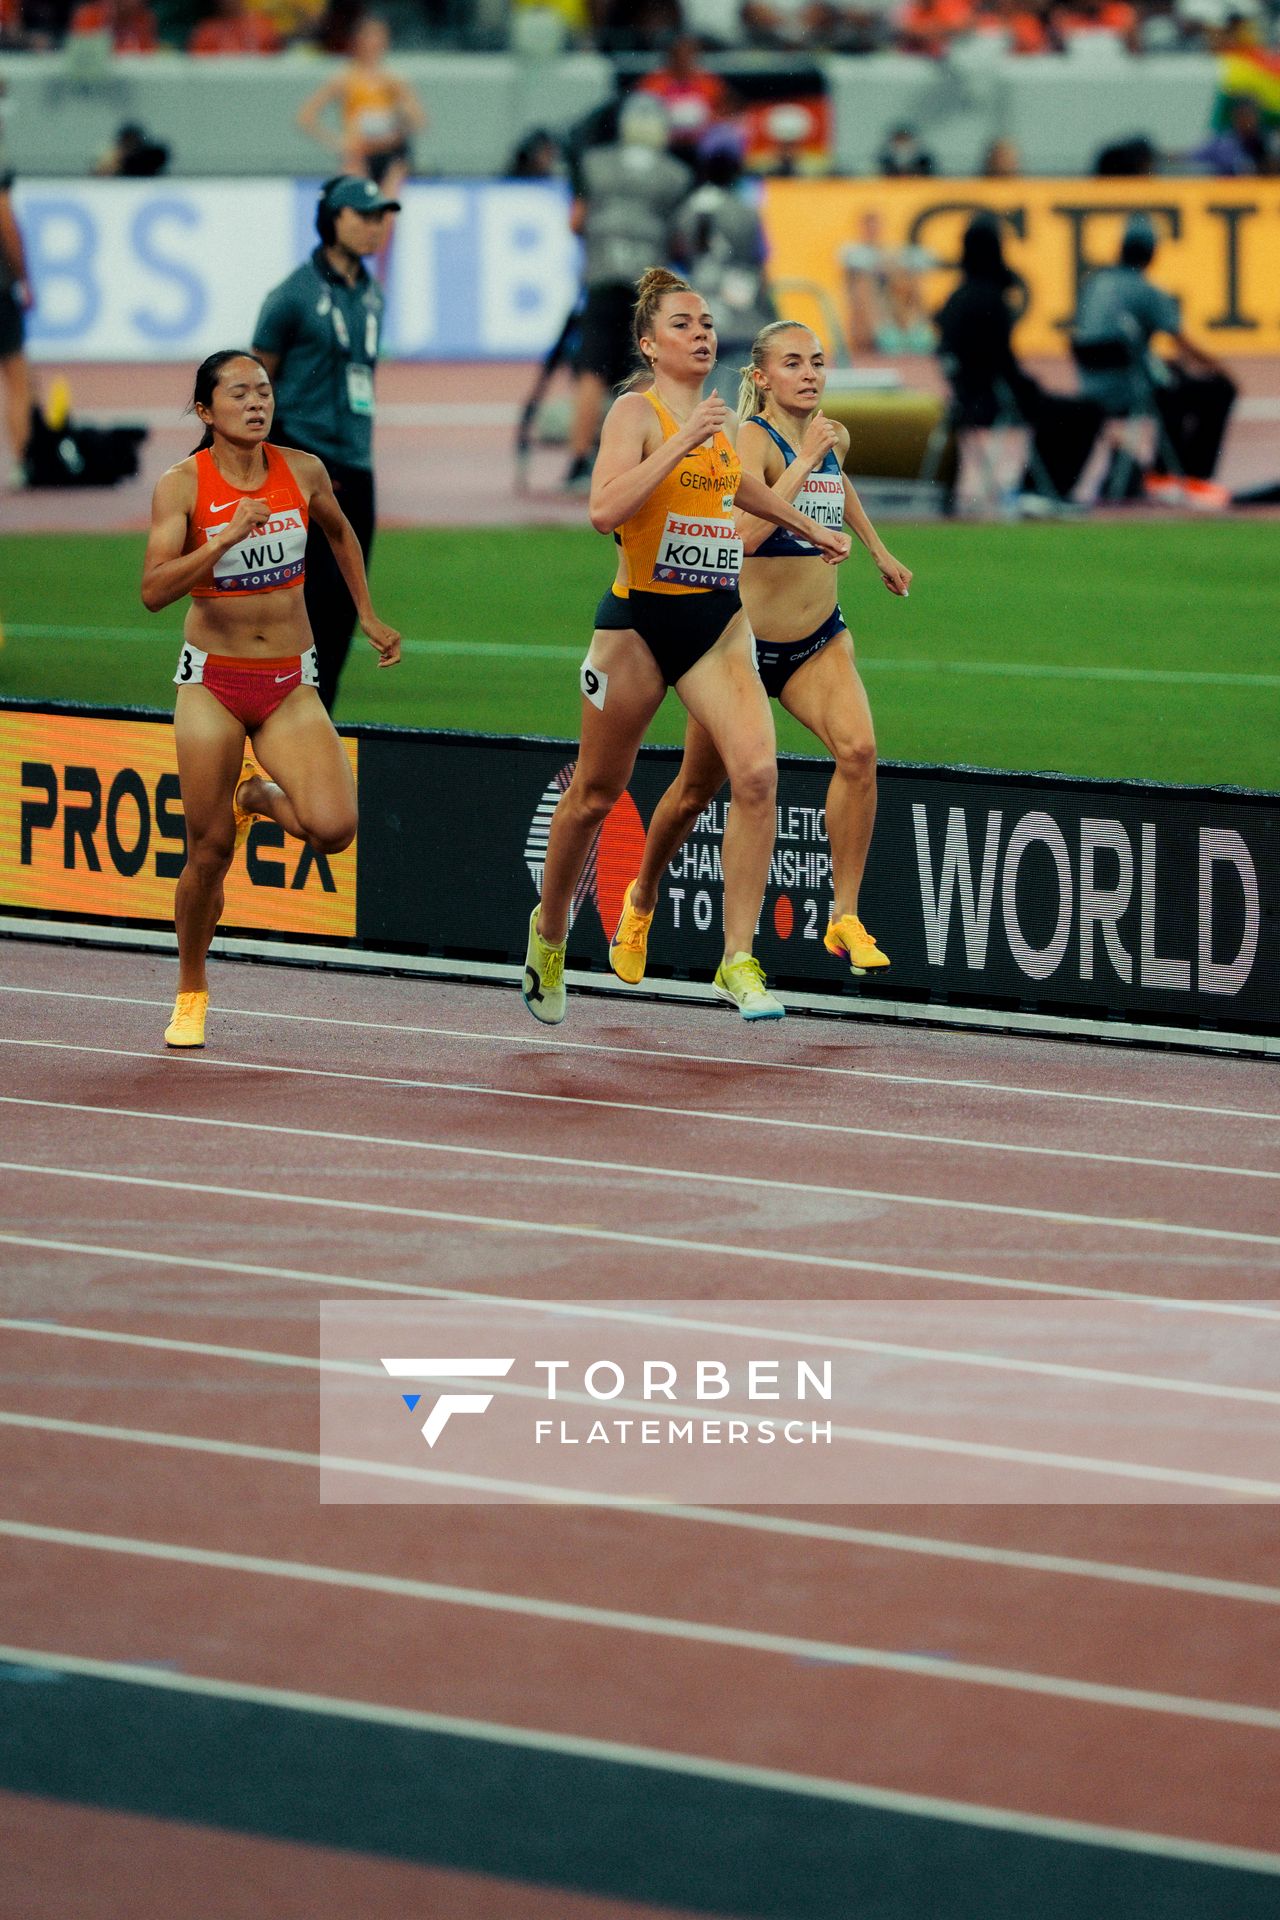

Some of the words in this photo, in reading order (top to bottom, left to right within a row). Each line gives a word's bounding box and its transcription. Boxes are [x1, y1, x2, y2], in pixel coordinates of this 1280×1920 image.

[680, 471, 738, 492] GERMANY
[240, 542, 284, 569] WU
[665, 543, 739, 570] KOLBE
[181, 650, 192, 681] 3
[585, 669, 599, 695] 9
[912, 803, 1260, 996] WORLD
